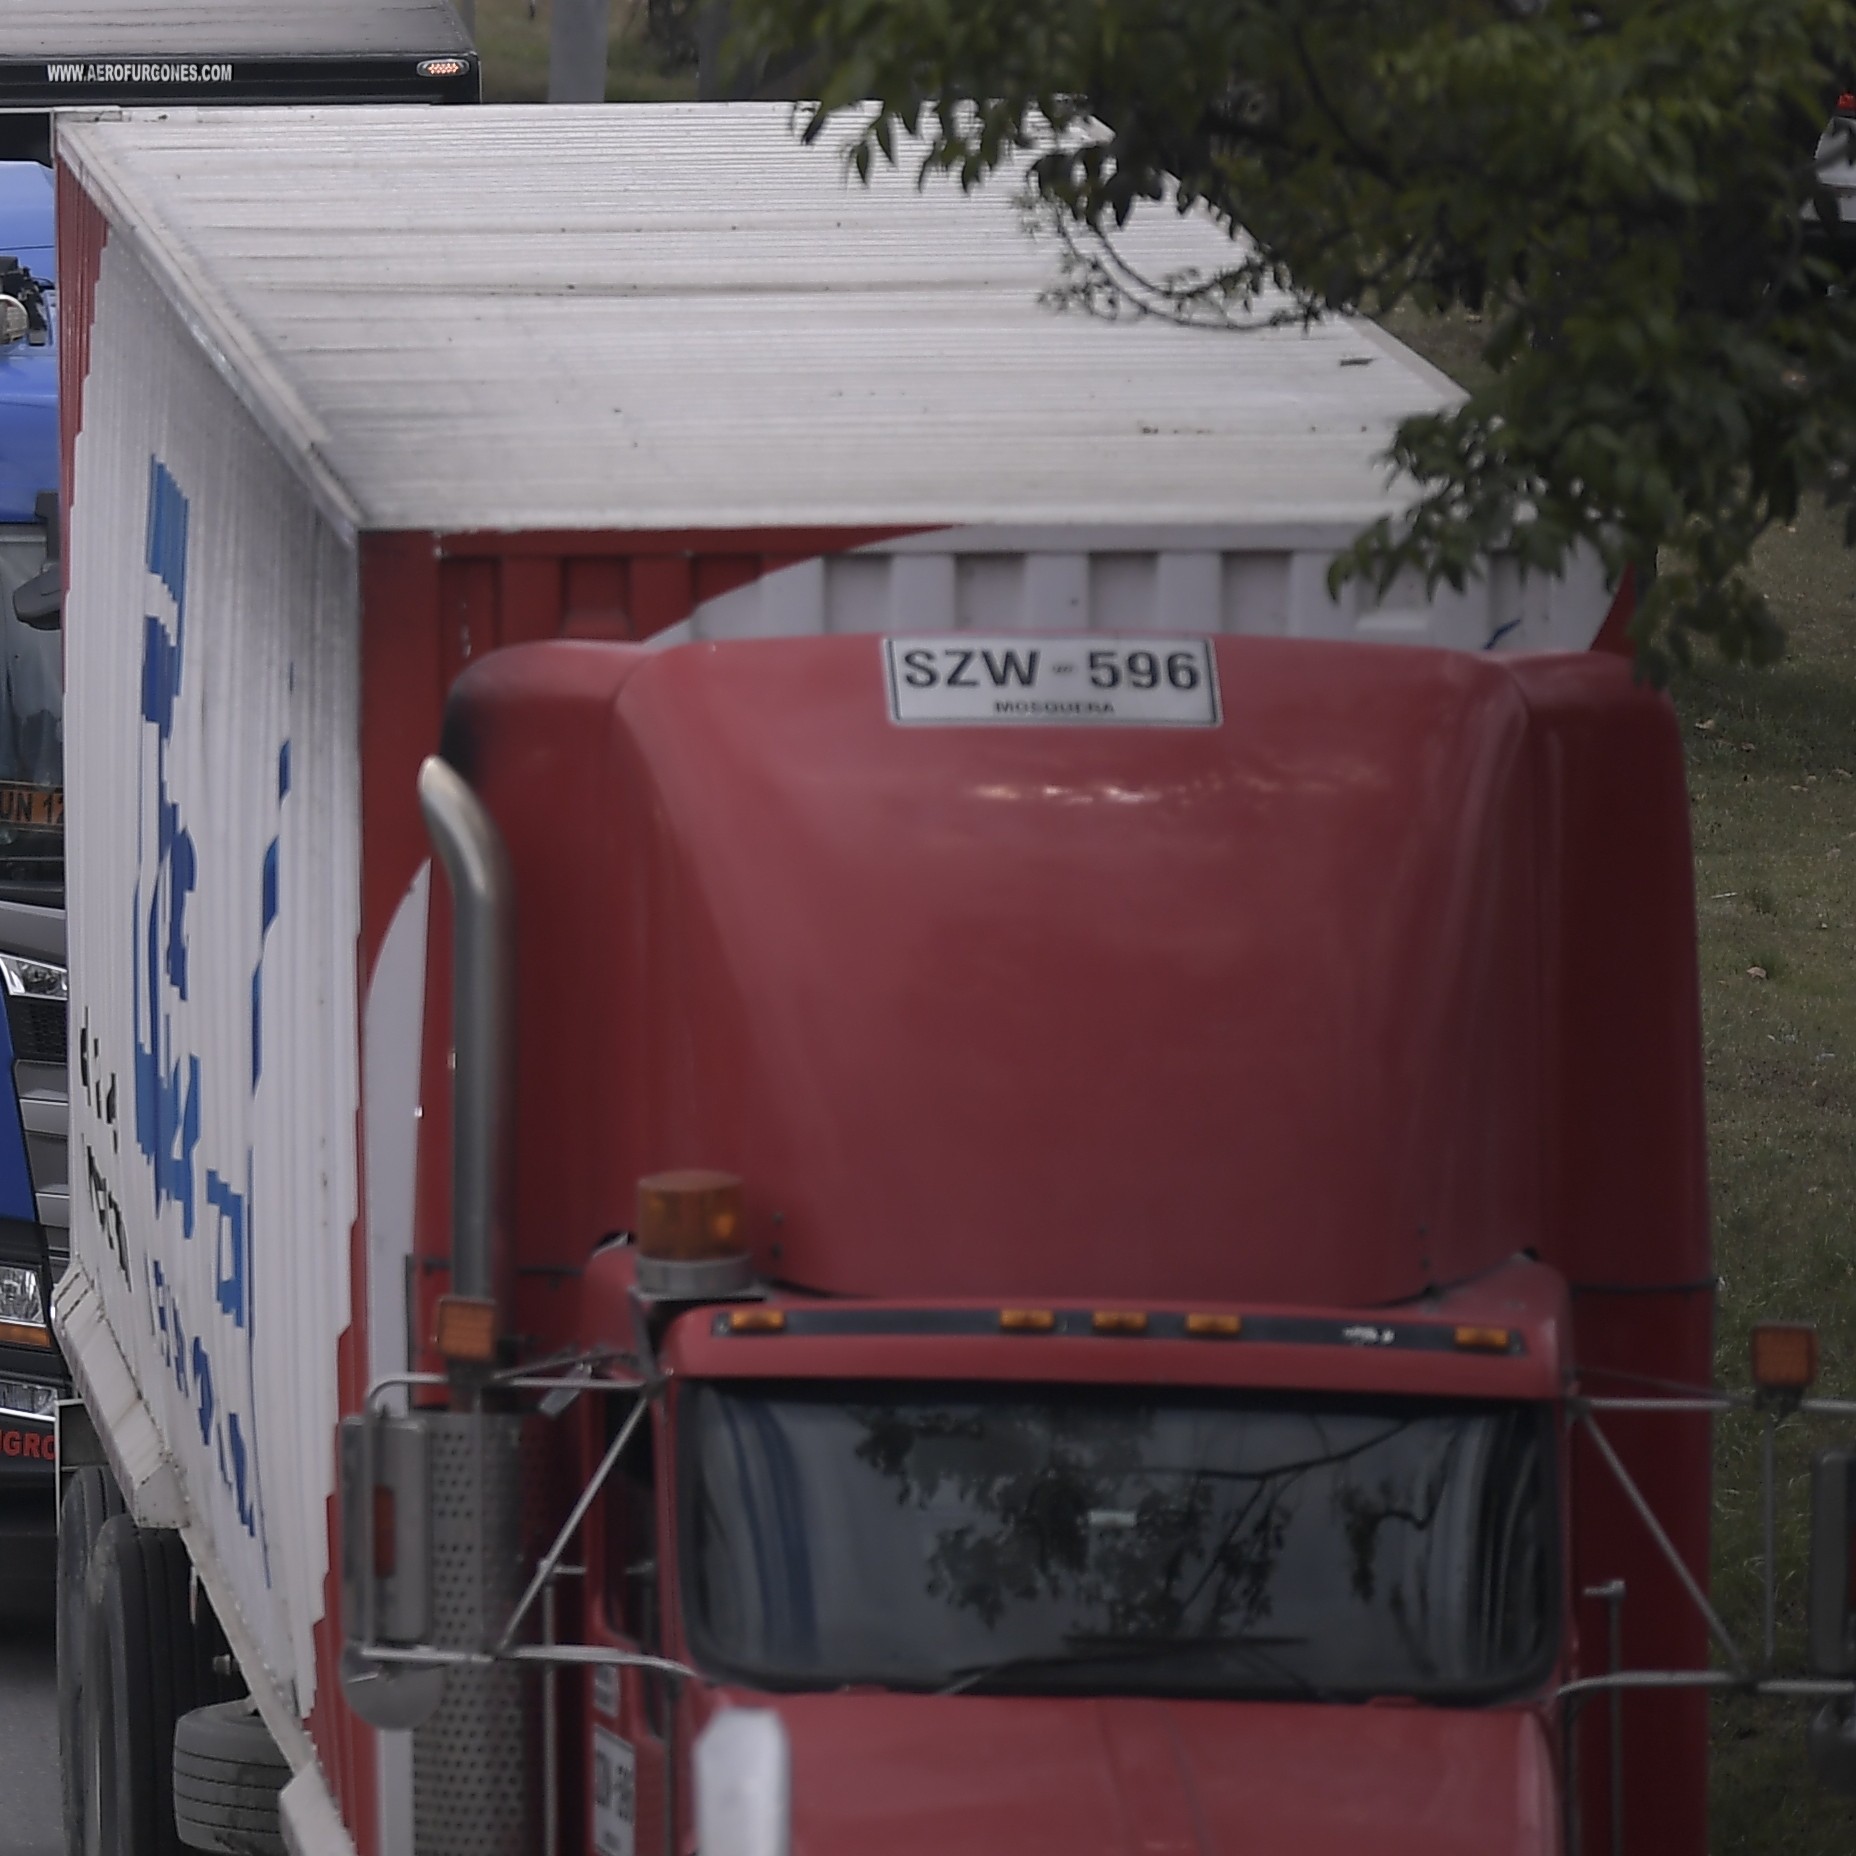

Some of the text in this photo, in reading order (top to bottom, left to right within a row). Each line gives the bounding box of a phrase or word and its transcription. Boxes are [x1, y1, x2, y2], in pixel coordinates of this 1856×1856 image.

[47, 63, 233, 83] WWW.AEROFURGONES.COM
[904, 649, 1197, 689] SZW 596
